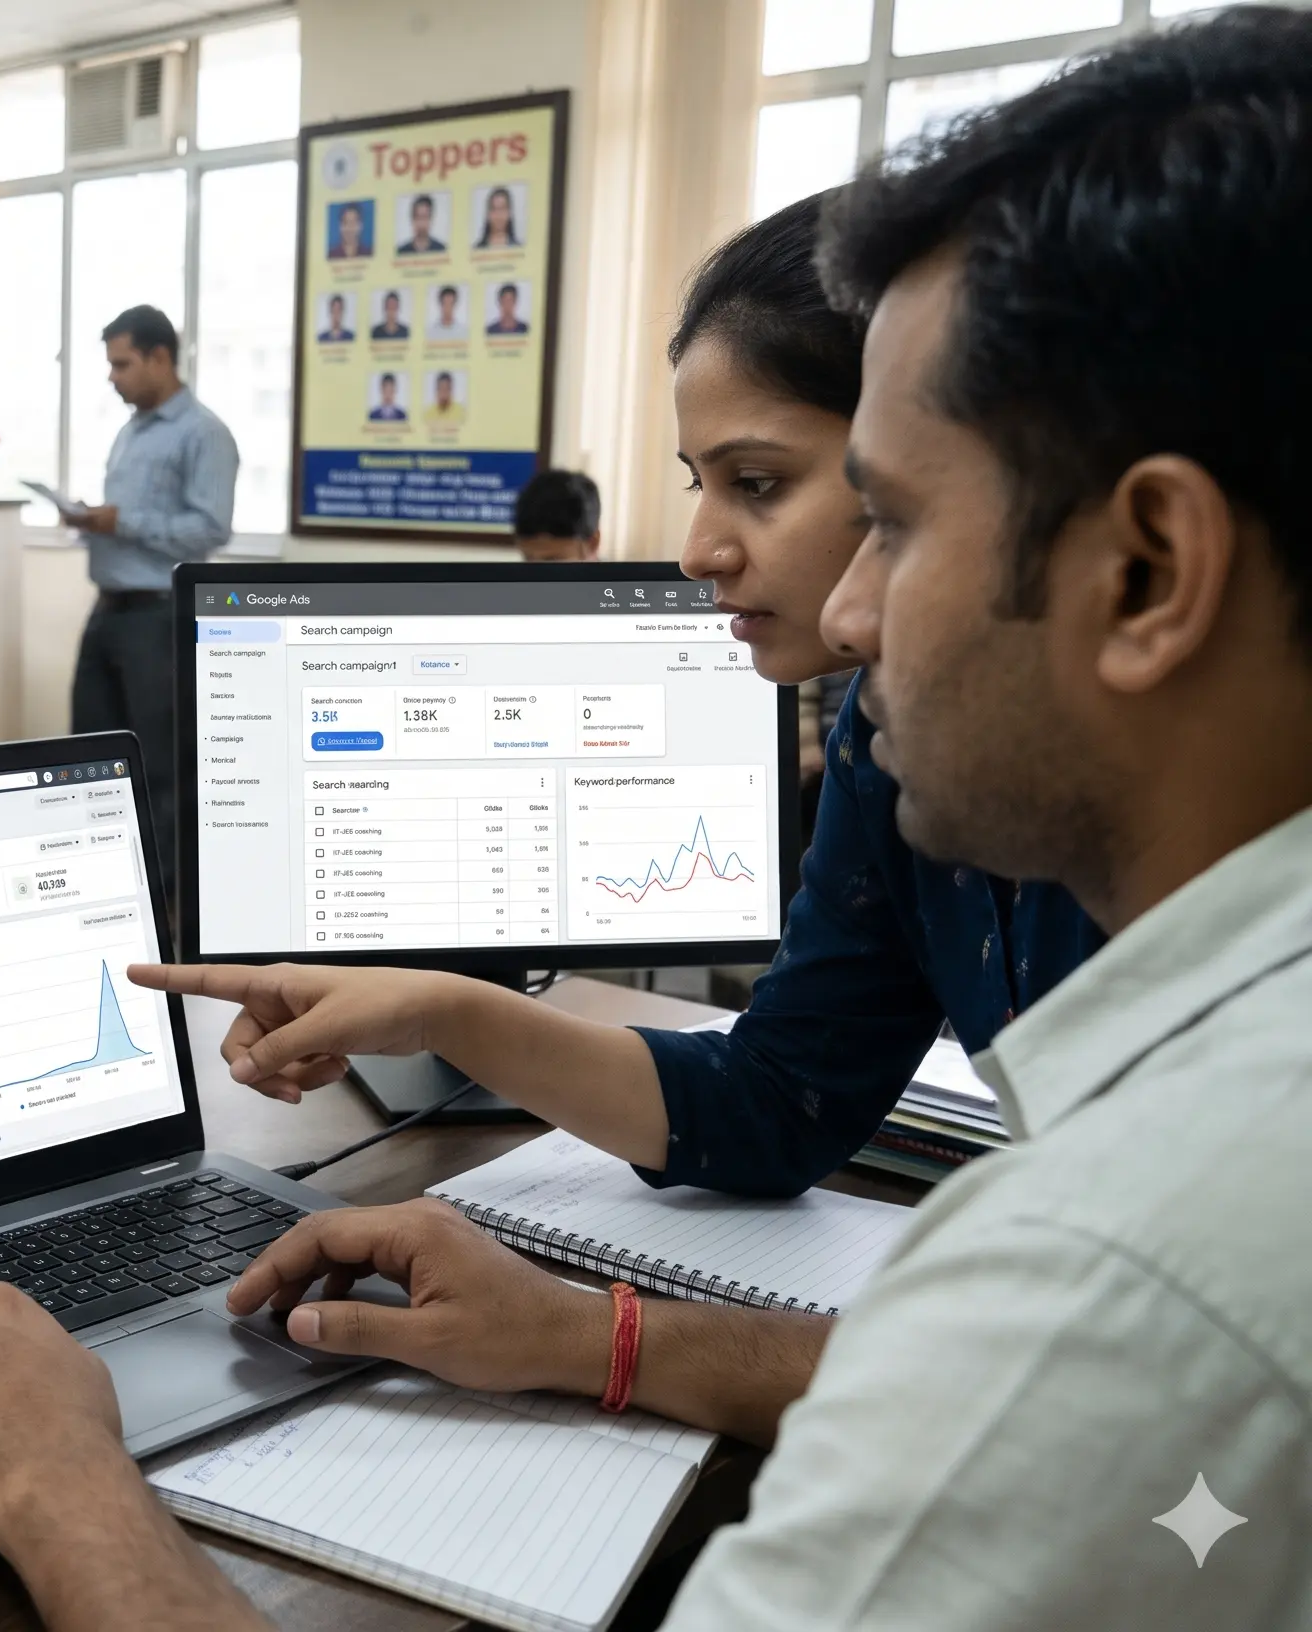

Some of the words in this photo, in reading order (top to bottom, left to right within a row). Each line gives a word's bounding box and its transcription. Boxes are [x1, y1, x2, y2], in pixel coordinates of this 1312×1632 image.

[369, 132, 529, 183] Toppers
[246, 594, 287, 607] Google
[290, 594, 311, 605] Ads
[301, 625, 338, 636] Search
[209, 649, 232, 657] Search
[302, 660, 338, 671] Search
[403, 710, 438, 722] 1.38K
[493, 709, 522, 721] 2.5K
[312, 779, 346, 790] Search
[574, 776, 614, 788] Keyword
[615, 776, 675, 788] performance
